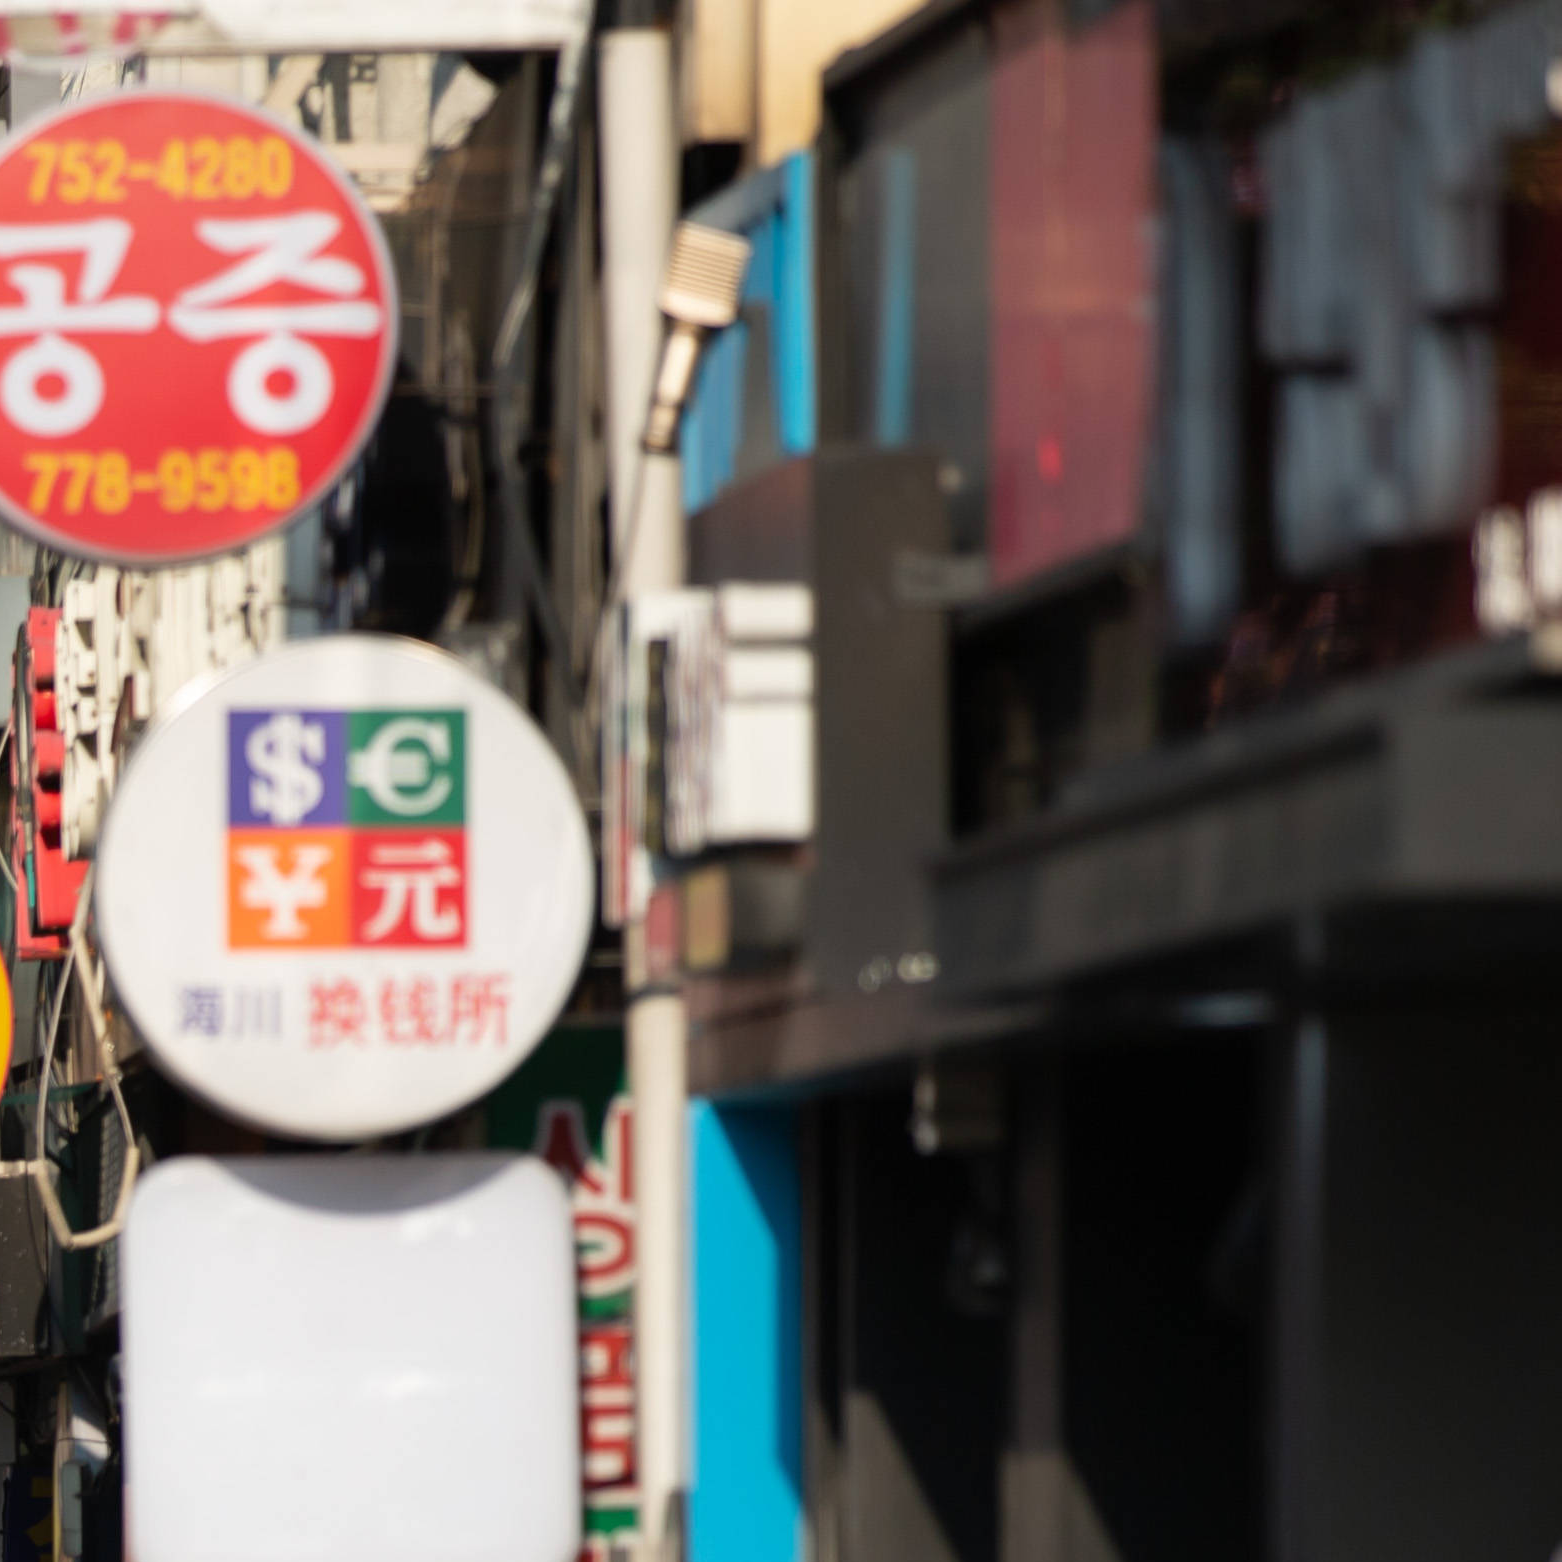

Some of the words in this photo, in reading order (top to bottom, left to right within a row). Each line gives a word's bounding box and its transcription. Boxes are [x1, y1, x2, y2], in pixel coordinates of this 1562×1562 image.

[24, 137, 295, 205] 752-4280
[245, 713, 326, 826] $
[349, 717, 453, 815] €
[235, 844, 333, 939] ¥
[360, 841, 463, 942] 元
